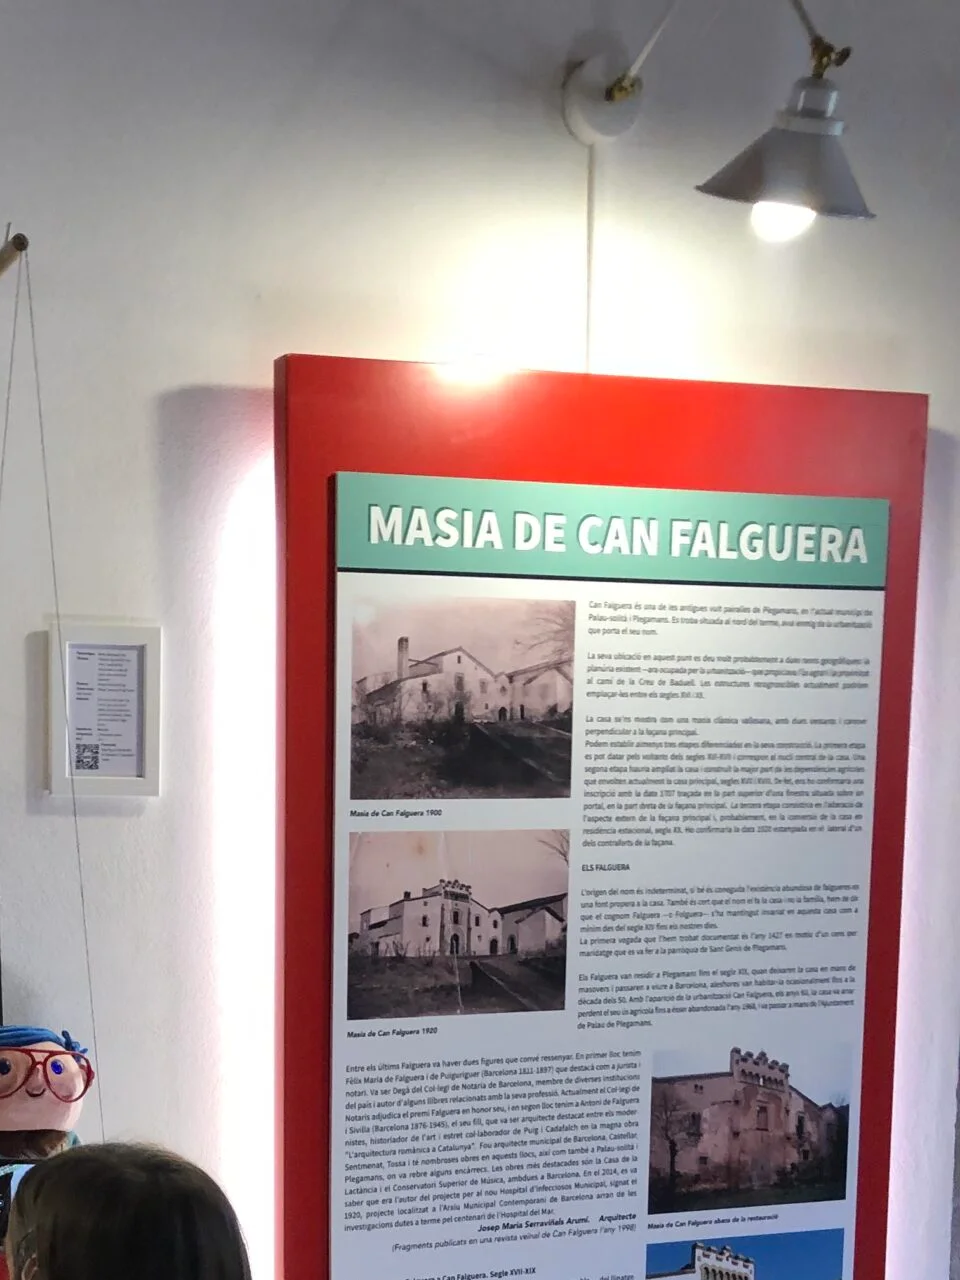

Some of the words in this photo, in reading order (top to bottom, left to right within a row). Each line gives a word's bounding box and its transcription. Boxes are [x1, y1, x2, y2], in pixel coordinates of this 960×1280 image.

[369, 505, 503, 549] MASIA
[514, 512, 567, 552] DE
[577, 515, 659, 556] CAN
[671, 519, 868, 563] FALGUERA
[490, 1270, 508, 1280] Segle
[510, 1267, 536, 1278] XVII-XIX
